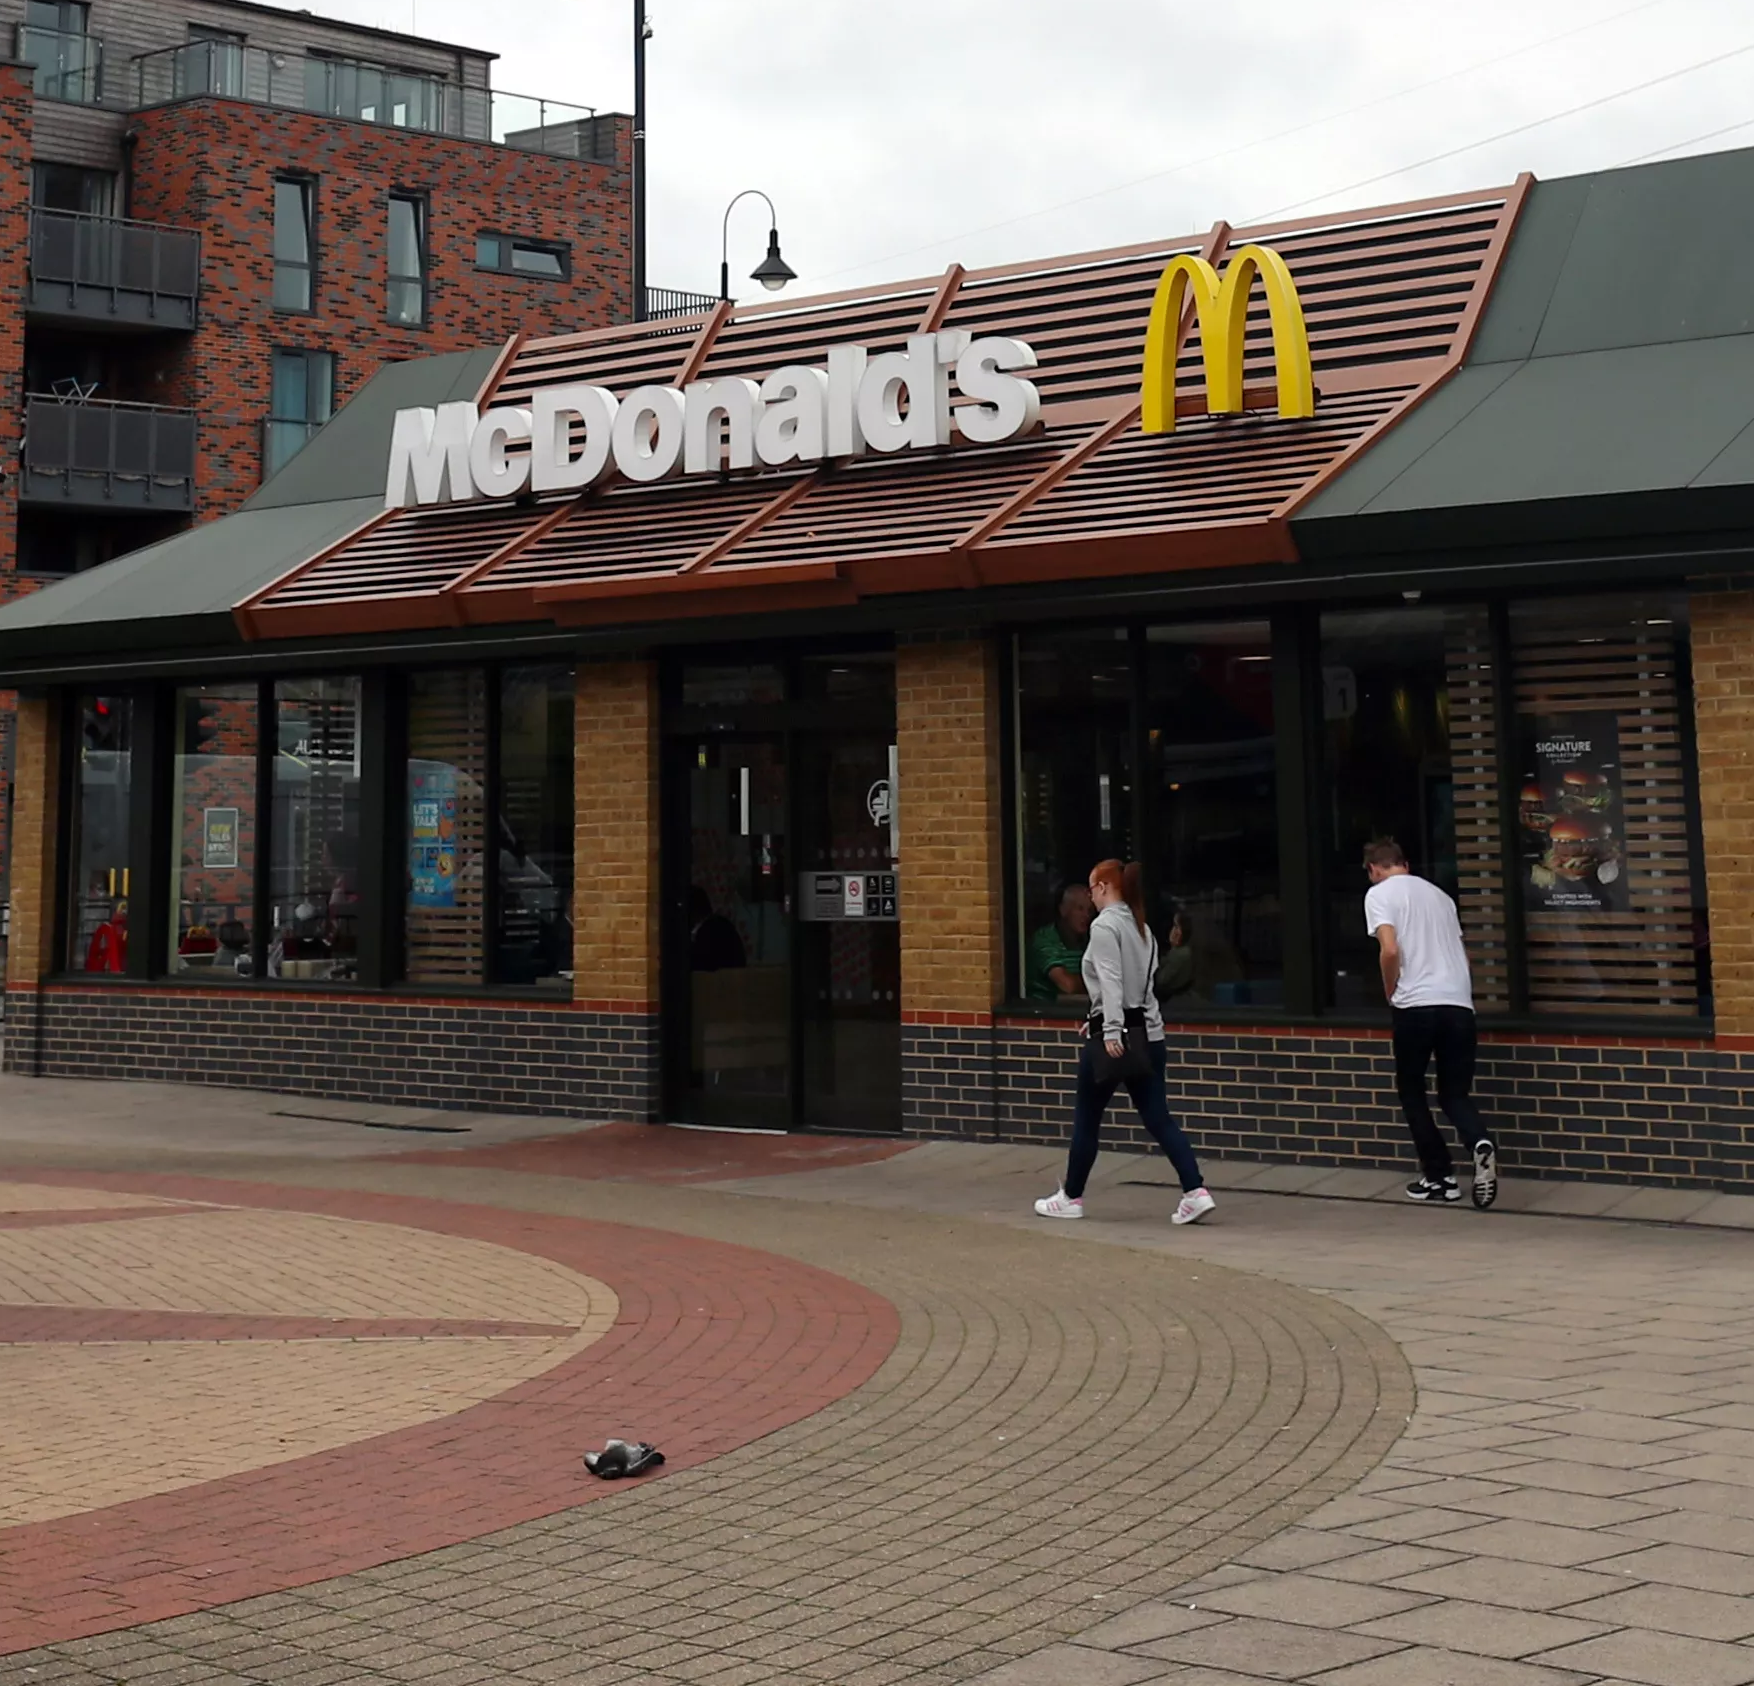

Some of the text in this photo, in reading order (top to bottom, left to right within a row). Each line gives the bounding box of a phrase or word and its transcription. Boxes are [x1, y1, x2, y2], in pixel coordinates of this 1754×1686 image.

[384, 328, 1040, 510] McDonald's
[1535, 741, 1591, 753] SIGNATURE
[414, 816, 438, 828] TALK
